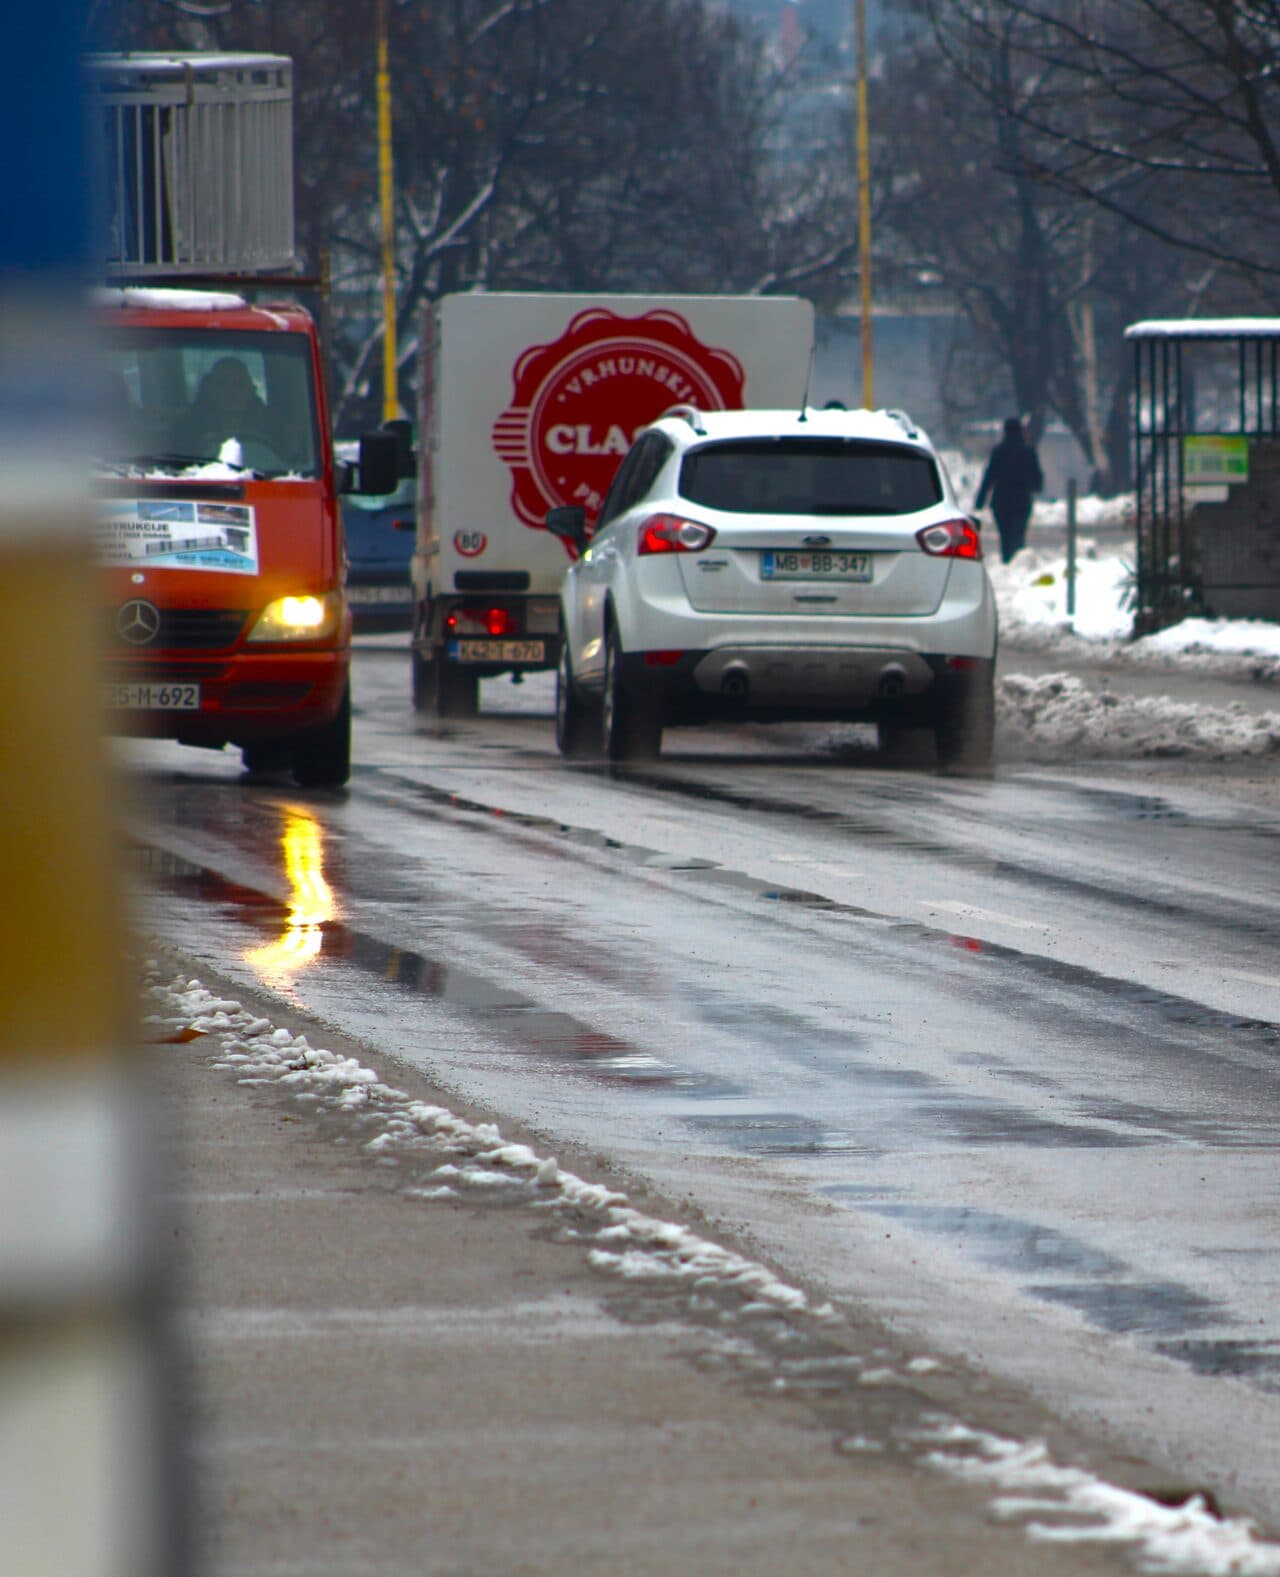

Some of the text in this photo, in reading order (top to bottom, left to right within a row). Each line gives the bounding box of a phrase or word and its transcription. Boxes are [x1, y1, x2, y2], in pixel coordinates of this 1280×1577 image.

[564, 357, 692, 399] VRHUNSKI
[775, 554, 868, 573] MB BB-347
